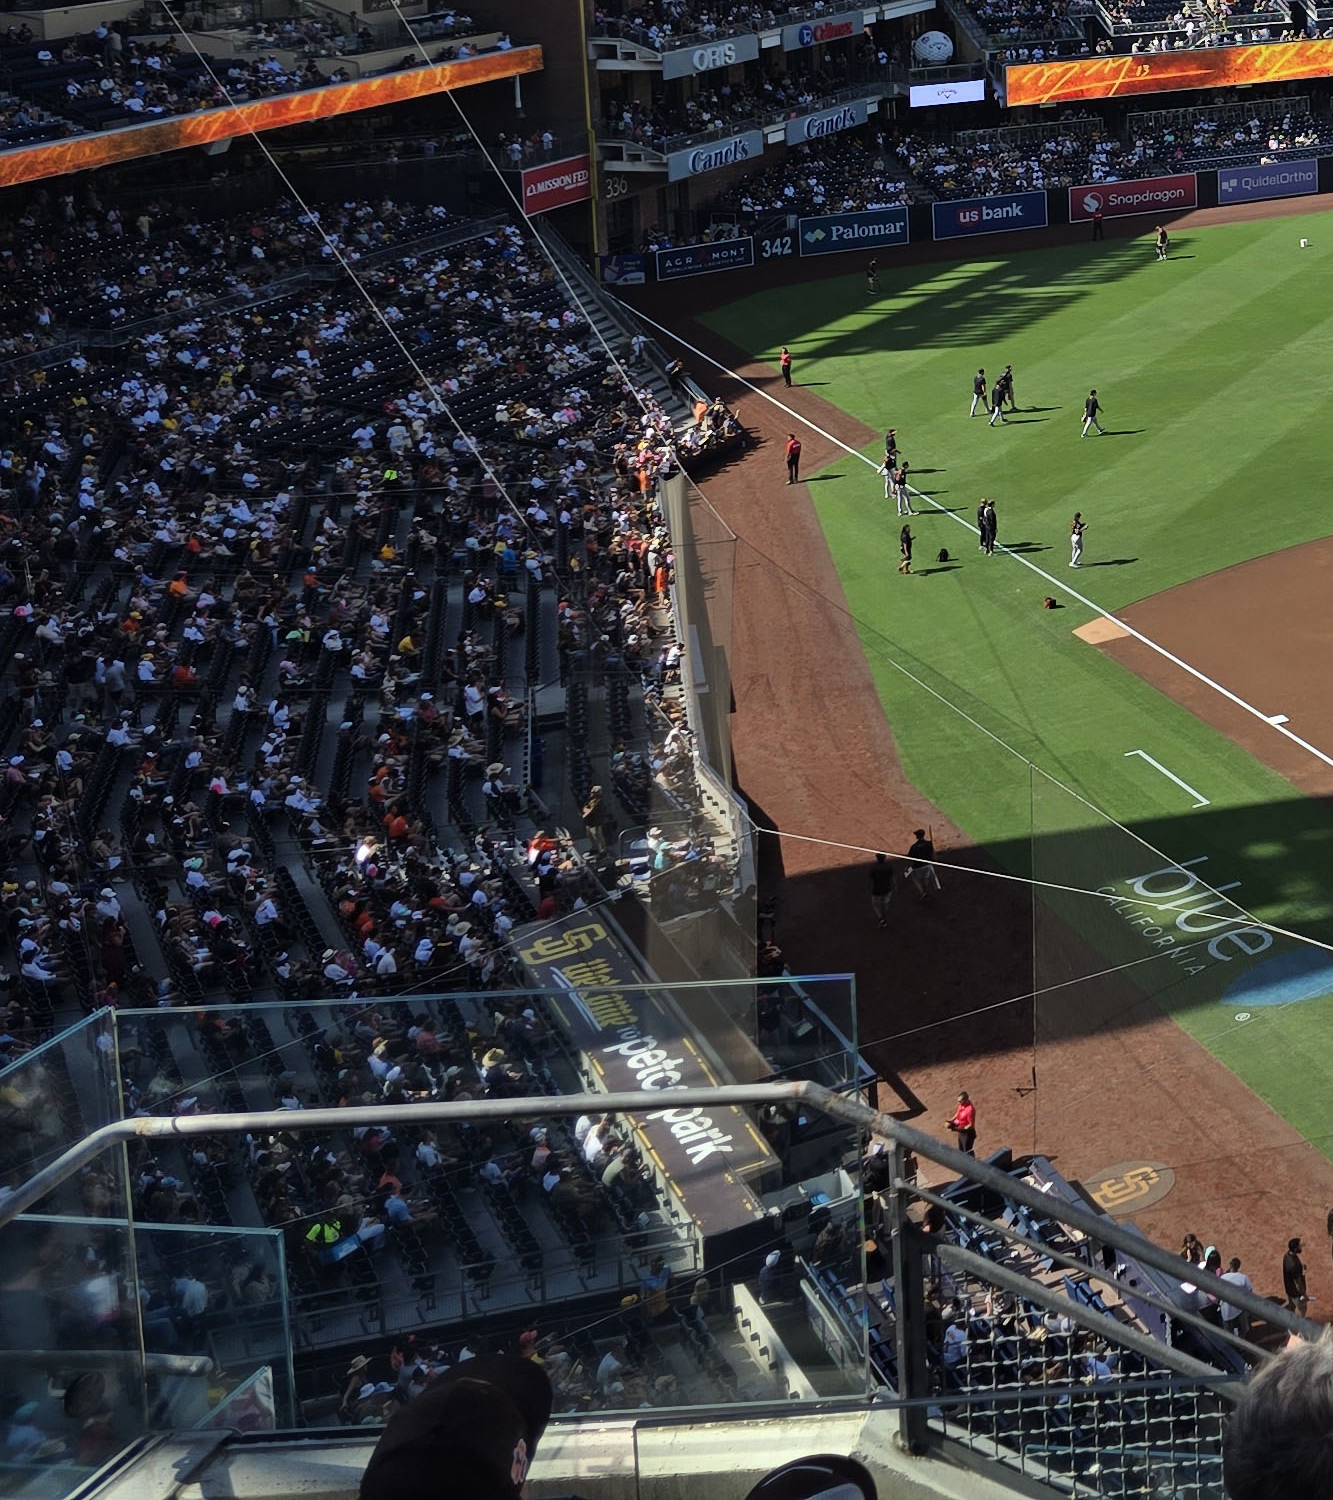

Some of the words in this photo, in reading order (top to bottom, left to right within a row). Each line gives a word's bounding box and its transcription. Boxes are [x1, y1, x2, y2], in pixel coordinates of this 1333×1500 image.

[693, 43, 736, 71] ORIS
[804, 106, 856, 140] Canel's
[689, 137, 749, 175] Canel's
[536, 173, 572, 193] MISSION
[573, 170, 588, 182] FED
[605, 174, 628, 199] 336
[1241, 169, 1315, 192] QuidelOrtho
[1108, 186, 1185, 206] Snapdragon
[958, 209, 980, 223] us
[981, 202, 1023, 221] bank
[831, 220, 905, 242] Palomar
[761, 236, 792, 258] 342
[1125, 856, 1274, 963] blue
[1096, 886, 1207, 977] CALIFORNIA
[603, 1035, 690, 1092] petc
